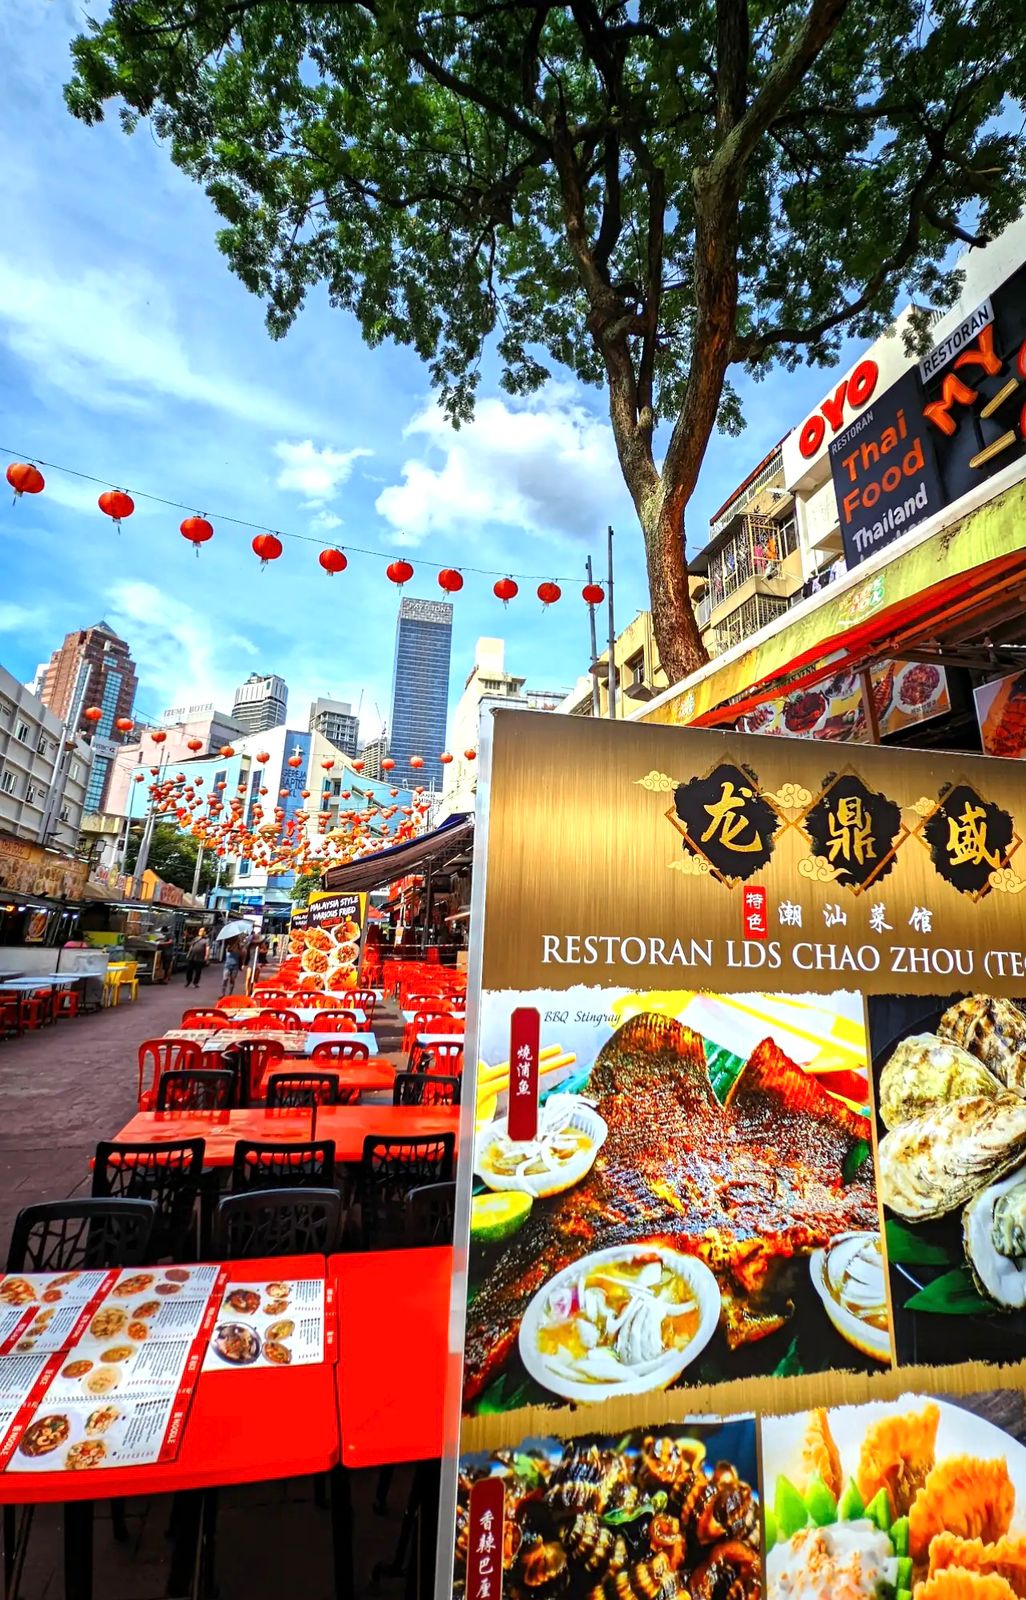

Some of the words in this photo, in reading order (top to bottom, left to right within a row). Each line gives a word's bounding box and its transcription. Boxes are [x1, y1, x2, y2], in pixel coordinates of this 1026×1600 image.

[923, 305, 989, 378] RESTORAN
[799, 360, 879, 458] OYO
[832, 410, 874, 456] RESTORAN
[842, 408, 908, 483] Thai
[843, 438, 926, 524] Food
[852, 482, 929, 553] Thailand
[189, 703, 214, 714] HOTEL
[700, 782, 1002, 870] 龙鼎盛
[310, 899, 339, 912] MALAYSIA
[340, 896, 358, 906] STYLE
[313, 909, 338, 920] VARIOUS
[339, 906, 356, 916] FRIED
[746, 893, 765, 932] 特色
[778, 900, 934, 934] 潮汕菜馆
[541, 934, 713, 967] RESTORAN
[726, 939, 782, 969] LDS
[792, 942, 880, 971] CHAO
[890, 946, 974, 975] ZHOU
[984, 951, 1026, 979] (TE
[544, 1011, 569, 1024] BBQ
[574, 1010, 621, 1027] Stingray
